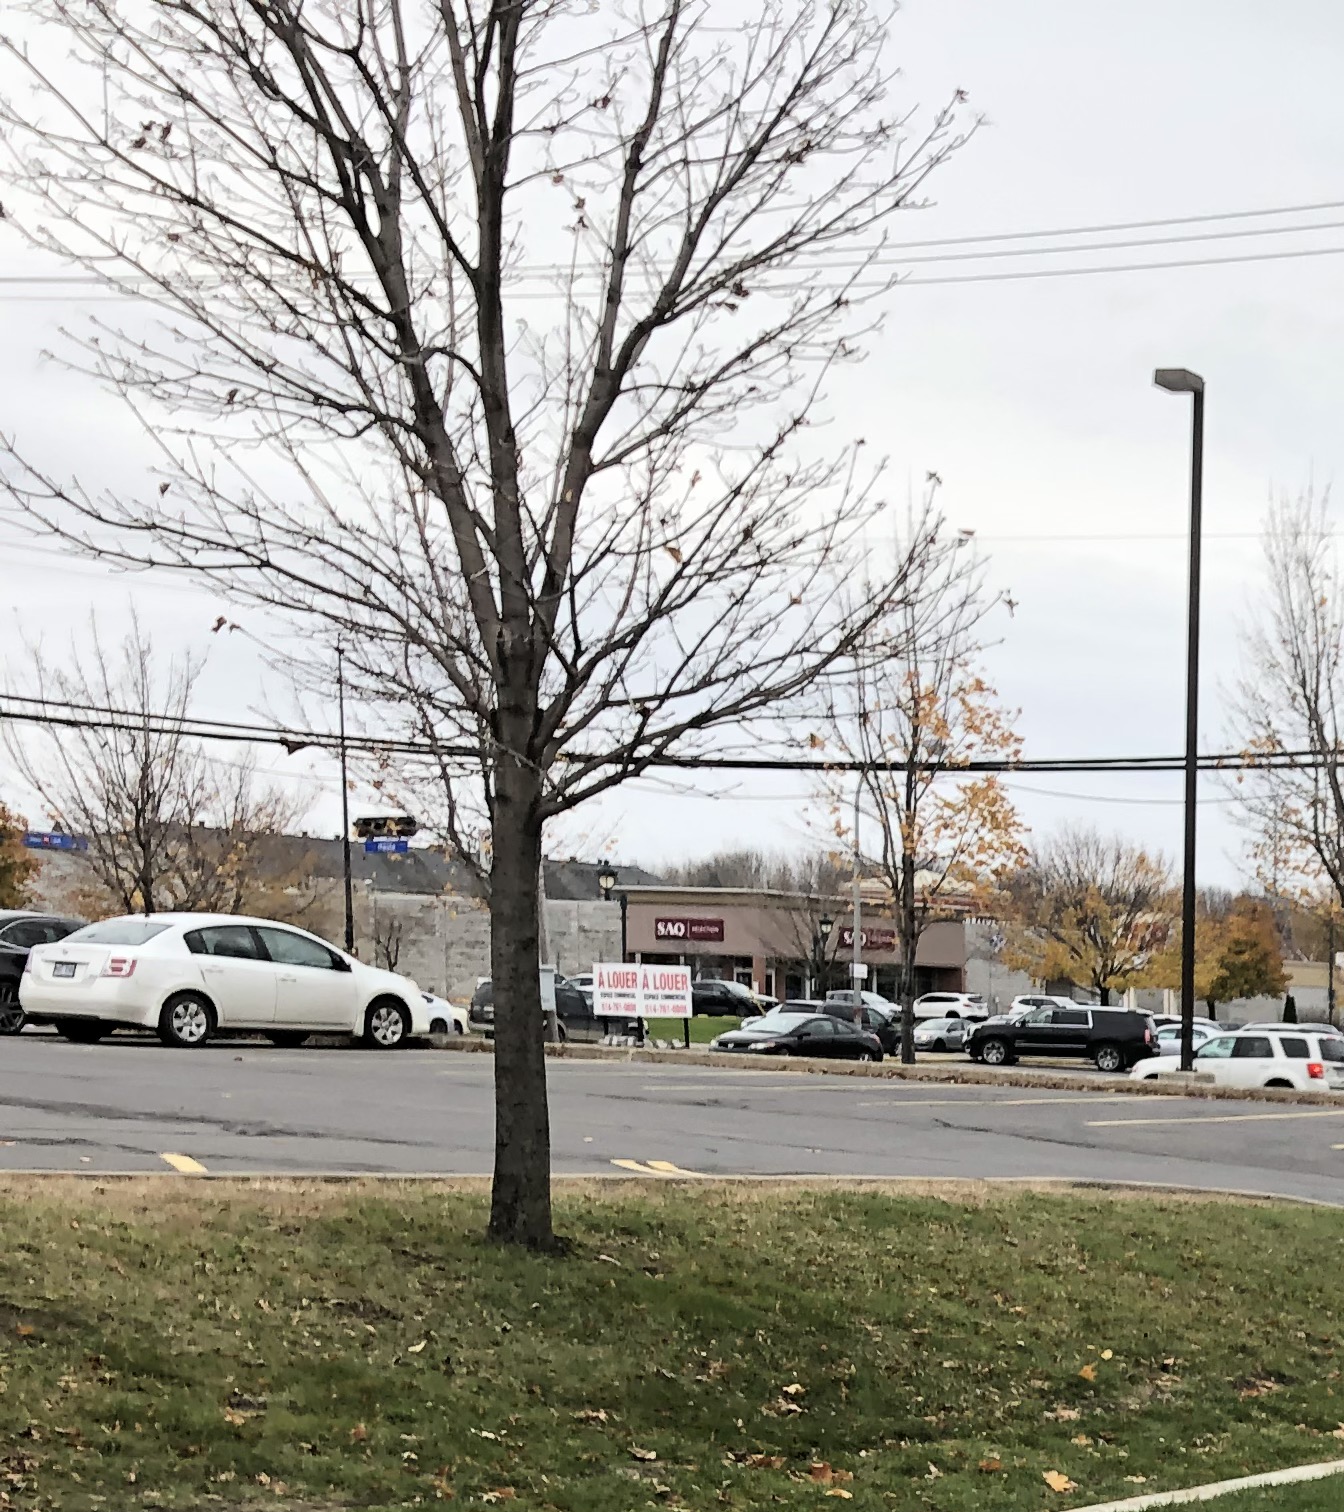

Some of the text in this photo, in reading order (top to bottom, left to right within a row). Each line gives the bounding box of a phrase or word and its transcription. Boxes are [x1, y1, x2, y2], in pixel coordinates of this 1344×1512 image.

[657, 921, 685, 937] SAQ
[843, 930, 867, 946] SQ
[598, 967, 638, 989] À LOUER
[642, 969, 689, 991] À LOUER
